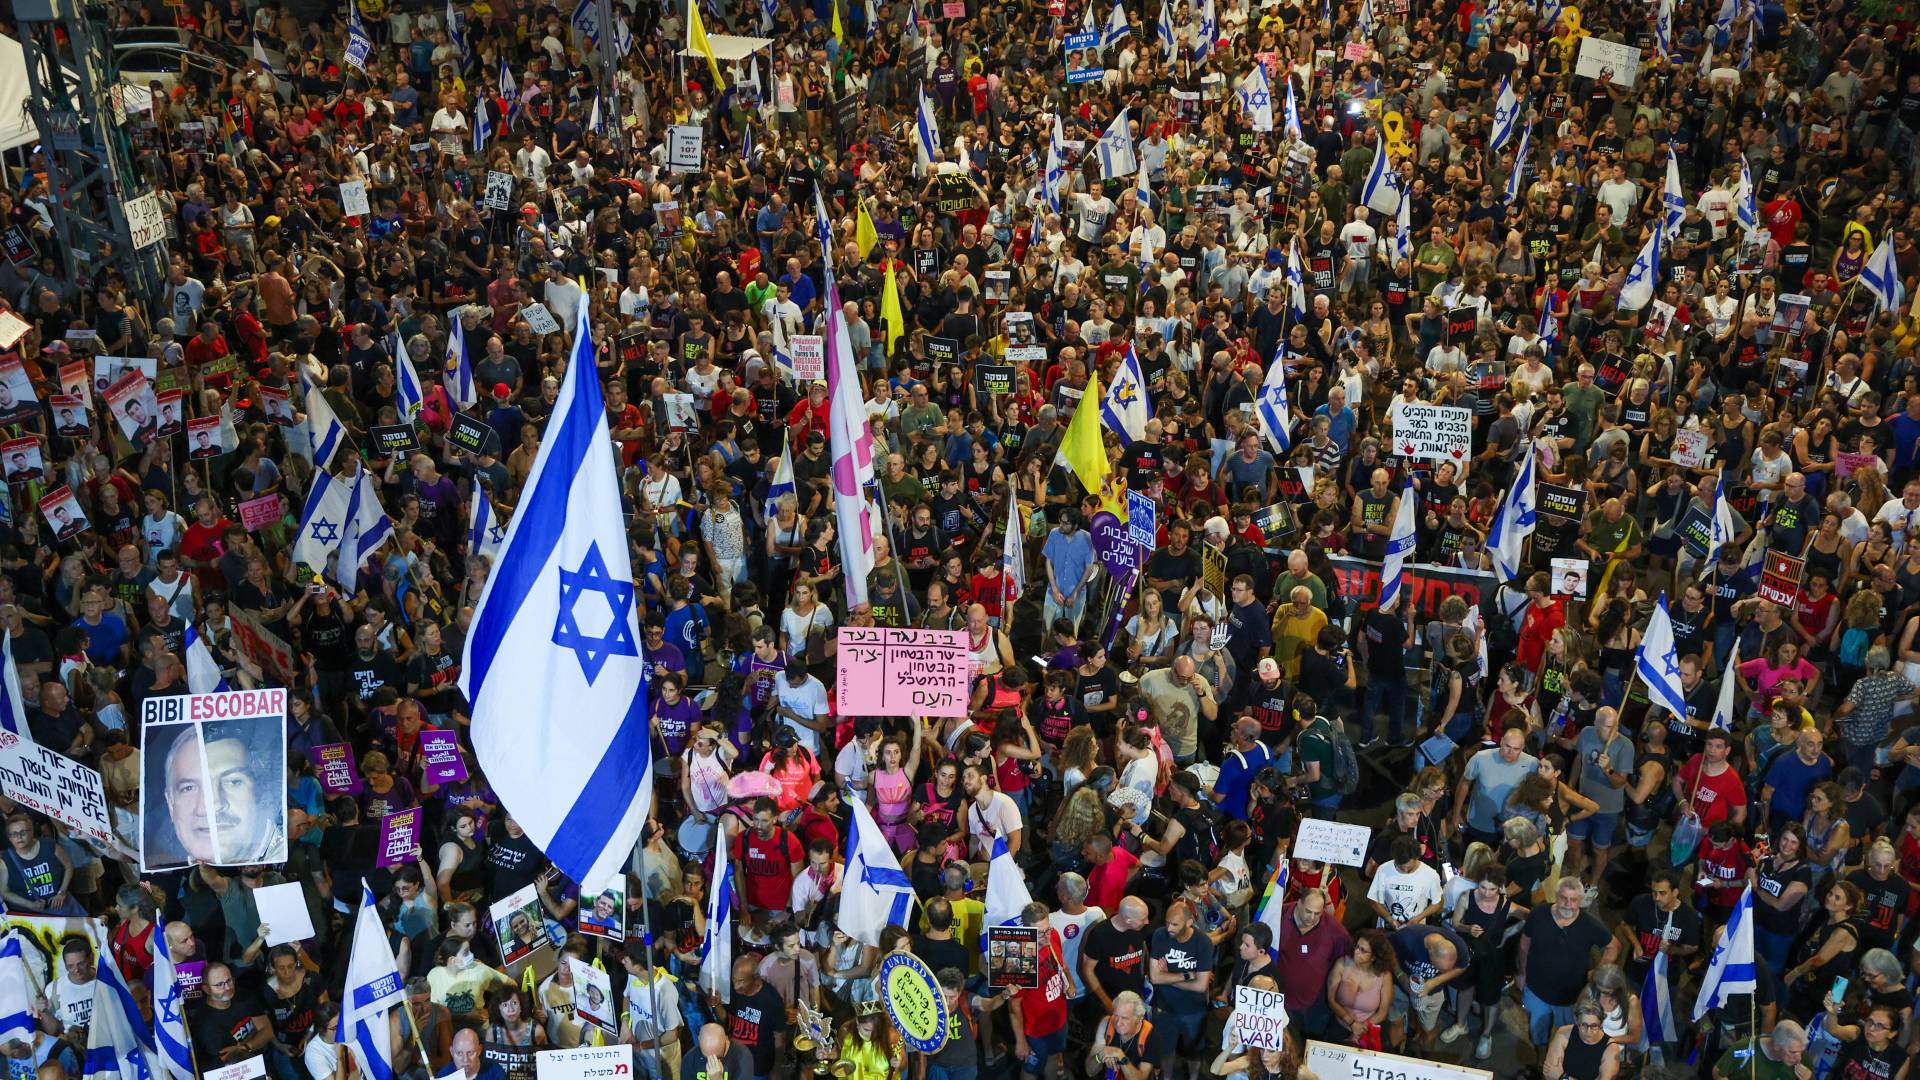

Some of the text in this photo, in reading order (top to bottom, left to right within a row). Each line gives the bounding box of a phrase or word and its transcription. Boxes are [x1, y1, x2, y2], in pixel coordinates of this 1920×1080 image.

[929, 342, 951, 351] עסקה
[625, 345, 651, 365] HELP
[793, 357, 822, 365] HOSTAGES
[984, 372, 1009, 380] עסקה
[1481, 373, 1505, 389] HELP
[1599, 363, 1626, 384] HELP
[1402, 406, 1470, 422] נתניהו והקבינט
[459, 423, 481, 437] עסקה
[1409, 419, 1467, 433] הצביעו בעד
[382, 431, 407, 440] עסקה
[1394, 429, 1470, 446] הפקרת החטופים
[1418, 441, 1449, 454] למוות
[1279, 480, 1303, 496] HELP
[1547, 492, 1577, 505] עסקה
[244, 499, 278, 518] SEAL
[1110, 539, 1134, 556] שלנו
[1761, 584, 1795, 606] עכשיו!
[872, 606, 899, 617] SEAL
[843, 630, 881, 642] בעד
[890, 648, 955, 664] שר הבטחון
[908, 662, 956, 675] הבטחון
[145, 690, 284, 724] BIBI ESCOBAR
[19, 755, 52, 781] זועק
[37, 746, 98, 786] קול אחי
[56, 789, 73, 810] מן
[386, 845, 412, 857] חיים
[1167, 948, 1187, 960] JUST
[886, 953, 946, 1044] UNITED STATES
[896, 977, 920, 1012] them
[903, 971, 930, 1010] Bring
[1239, 986, 1285, 1010] STOP
[1246, 1003, 1268, 1016] THE
[880, 986, 924, 1050] CONGRESS
[1235, 1013, 1282, 1034] BLOODY
[1238, 1028, 1281, 1050] WAR!
[485, 1049, 508, 1062] כולם
[549, 1050, 620, 1063] החטופים על
